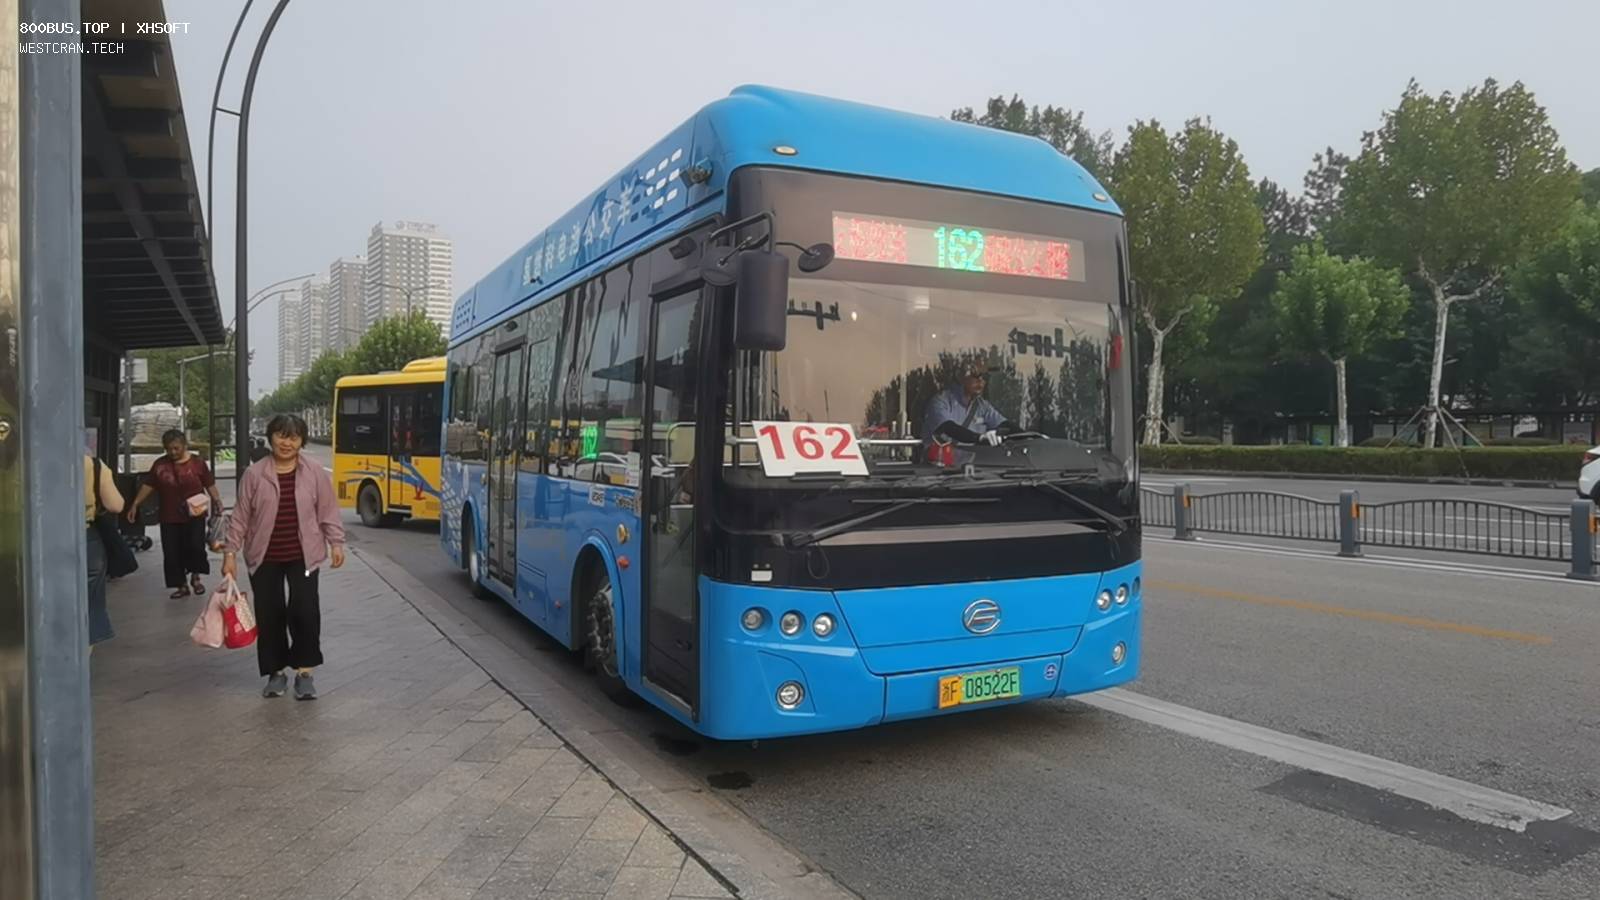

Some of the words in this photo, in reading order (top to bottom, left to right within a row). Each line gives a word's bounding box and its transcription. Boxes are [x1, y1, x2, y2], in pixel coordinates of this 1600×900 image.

[933, 226, 985, 272] 162
[759, 424, 859, 460] 162
[965, 672, 1017, 698] 08522F
